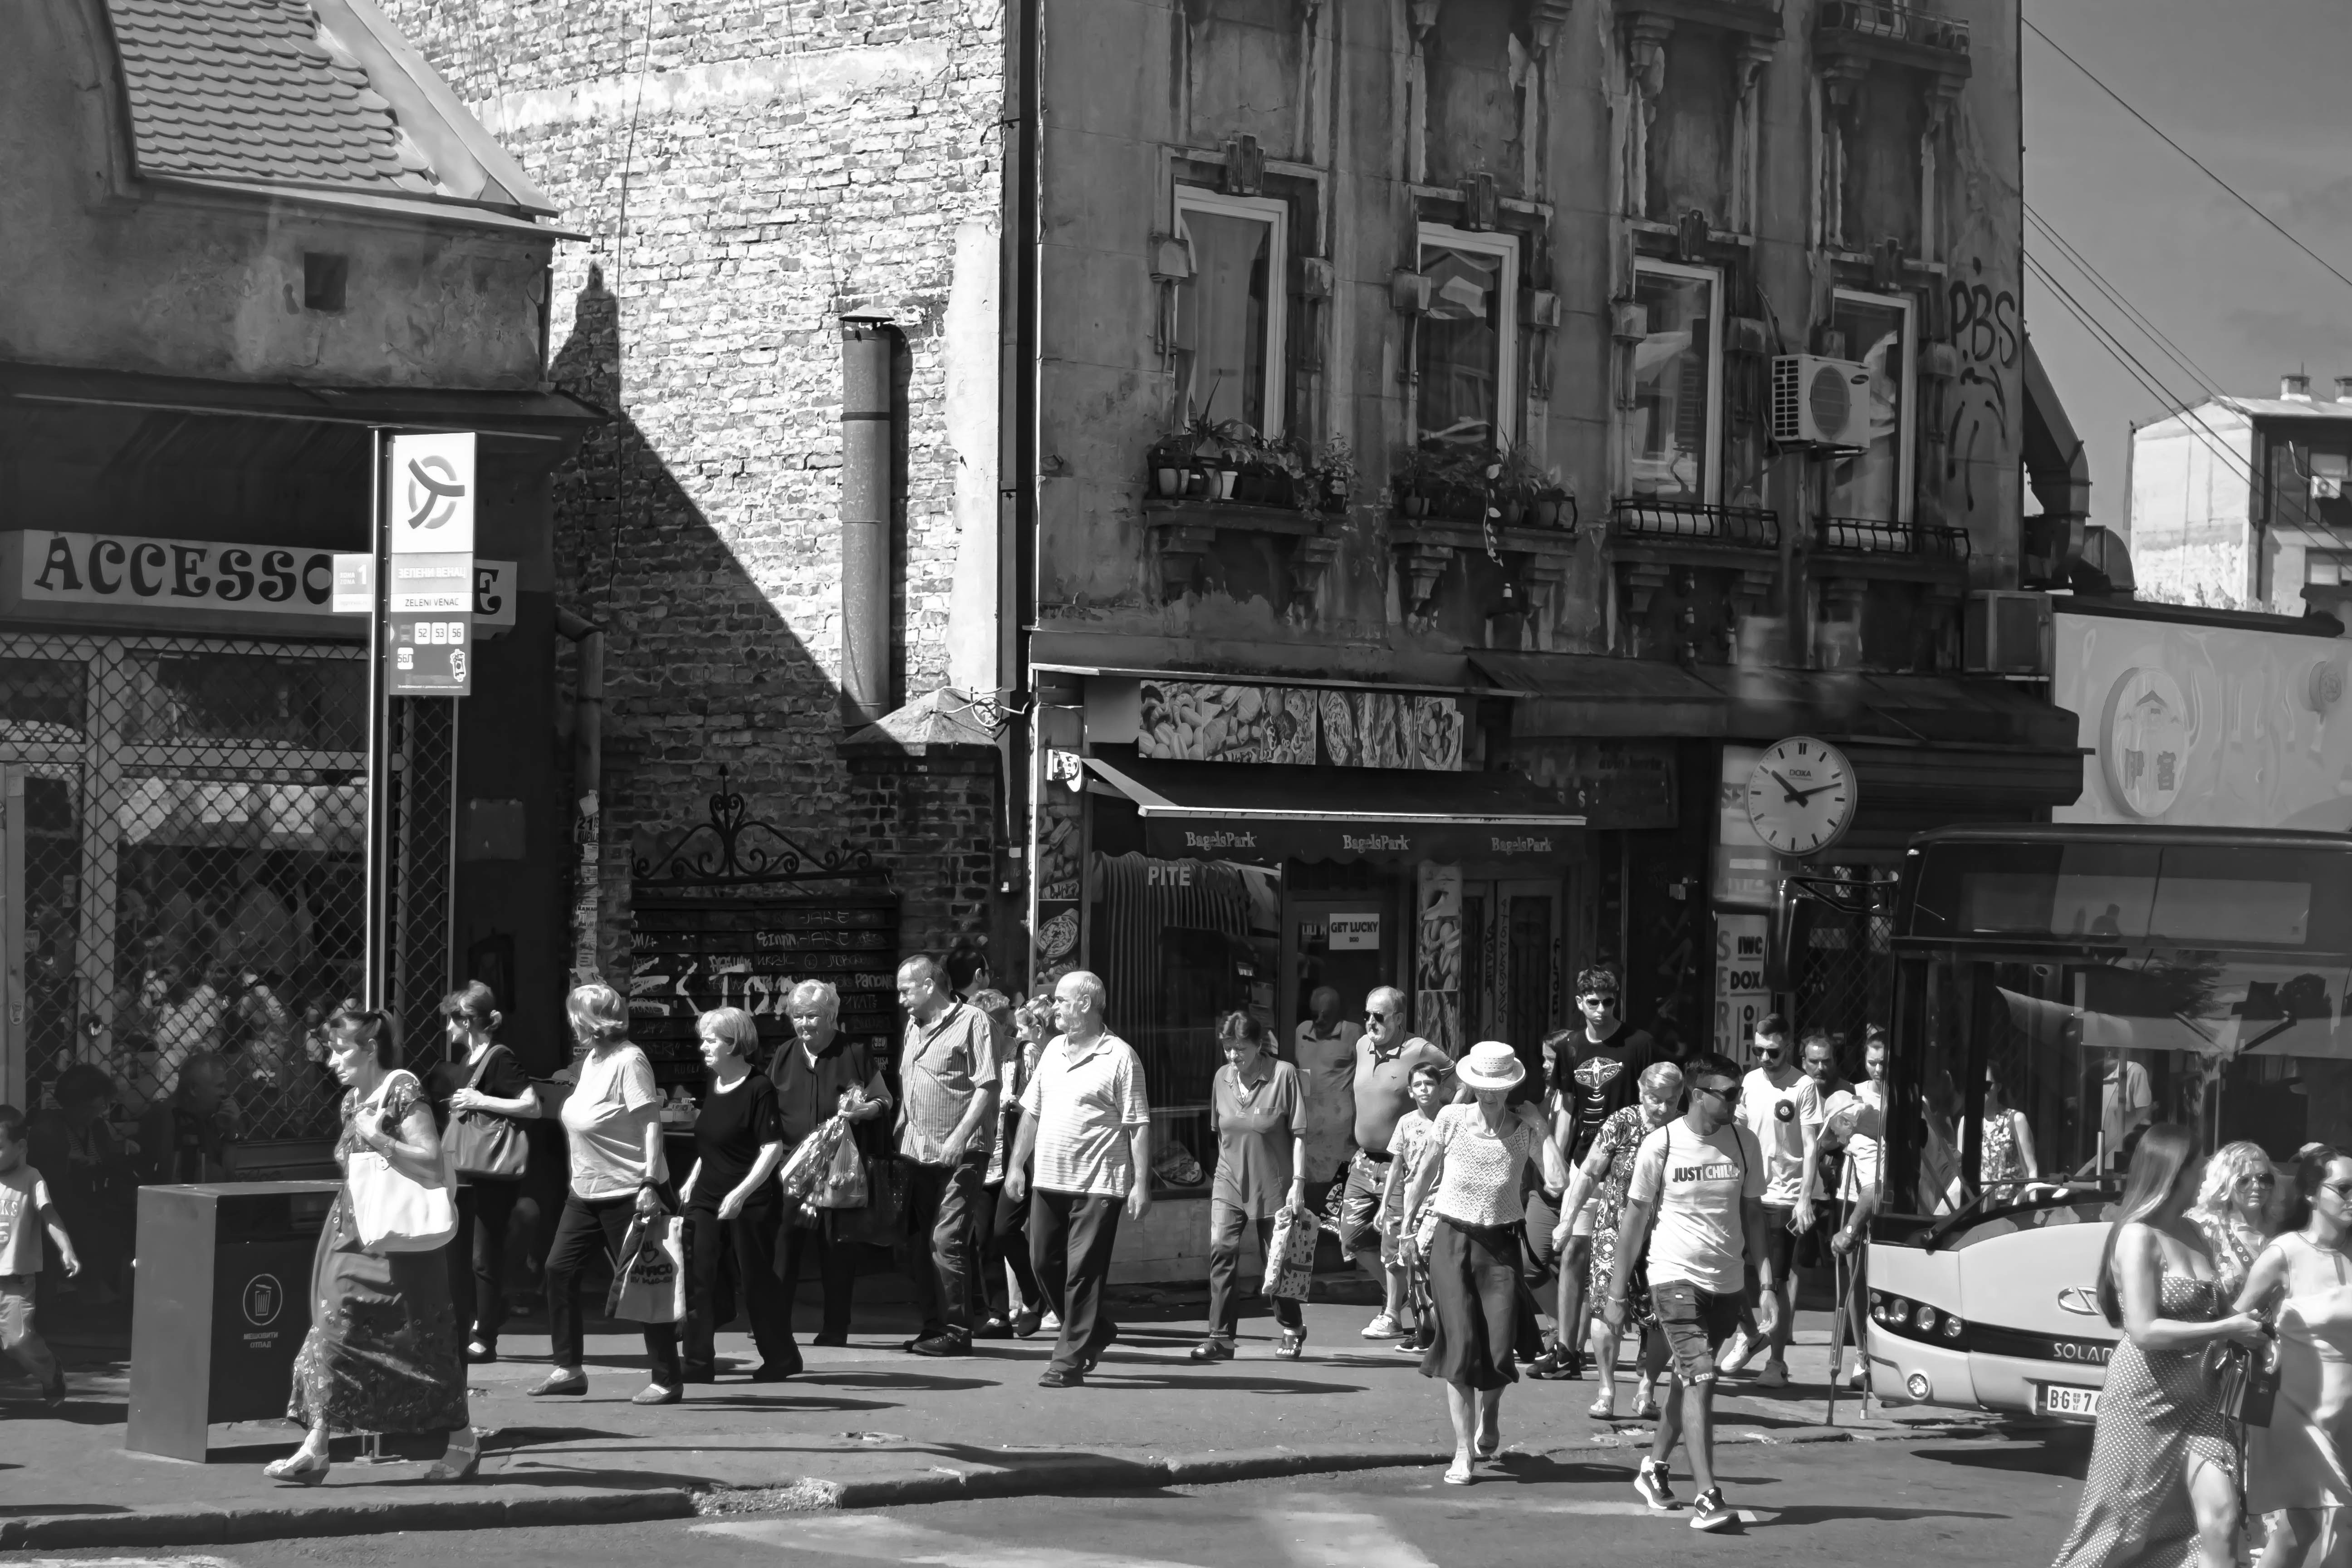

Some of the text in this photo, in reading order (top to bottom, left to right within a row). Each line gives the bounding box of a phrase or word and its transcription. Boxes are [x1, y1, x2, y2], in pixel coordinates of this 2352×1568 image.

[33, 536, 502, 616] ACCESSOE
[358, 564, 367, 585] 1
[405, 598, 459, 607] ZELENI VENAC
[418, 628, 461, 637] 52 53 56
[1789, 769, 1812, 777] DOXA
[1148, 866, 1191, 886] PITE
[1331, 922, 1348, 933] GET
[1350, 921, 1378, 933] LUCKY
[1738, 936, 1763, 955] IWC
[1672, 1166, 1702, 1183] JUST
[2053, 1343, 2113, 1362] SOLAR
[2050, 1389, 2070, 1410] BG
